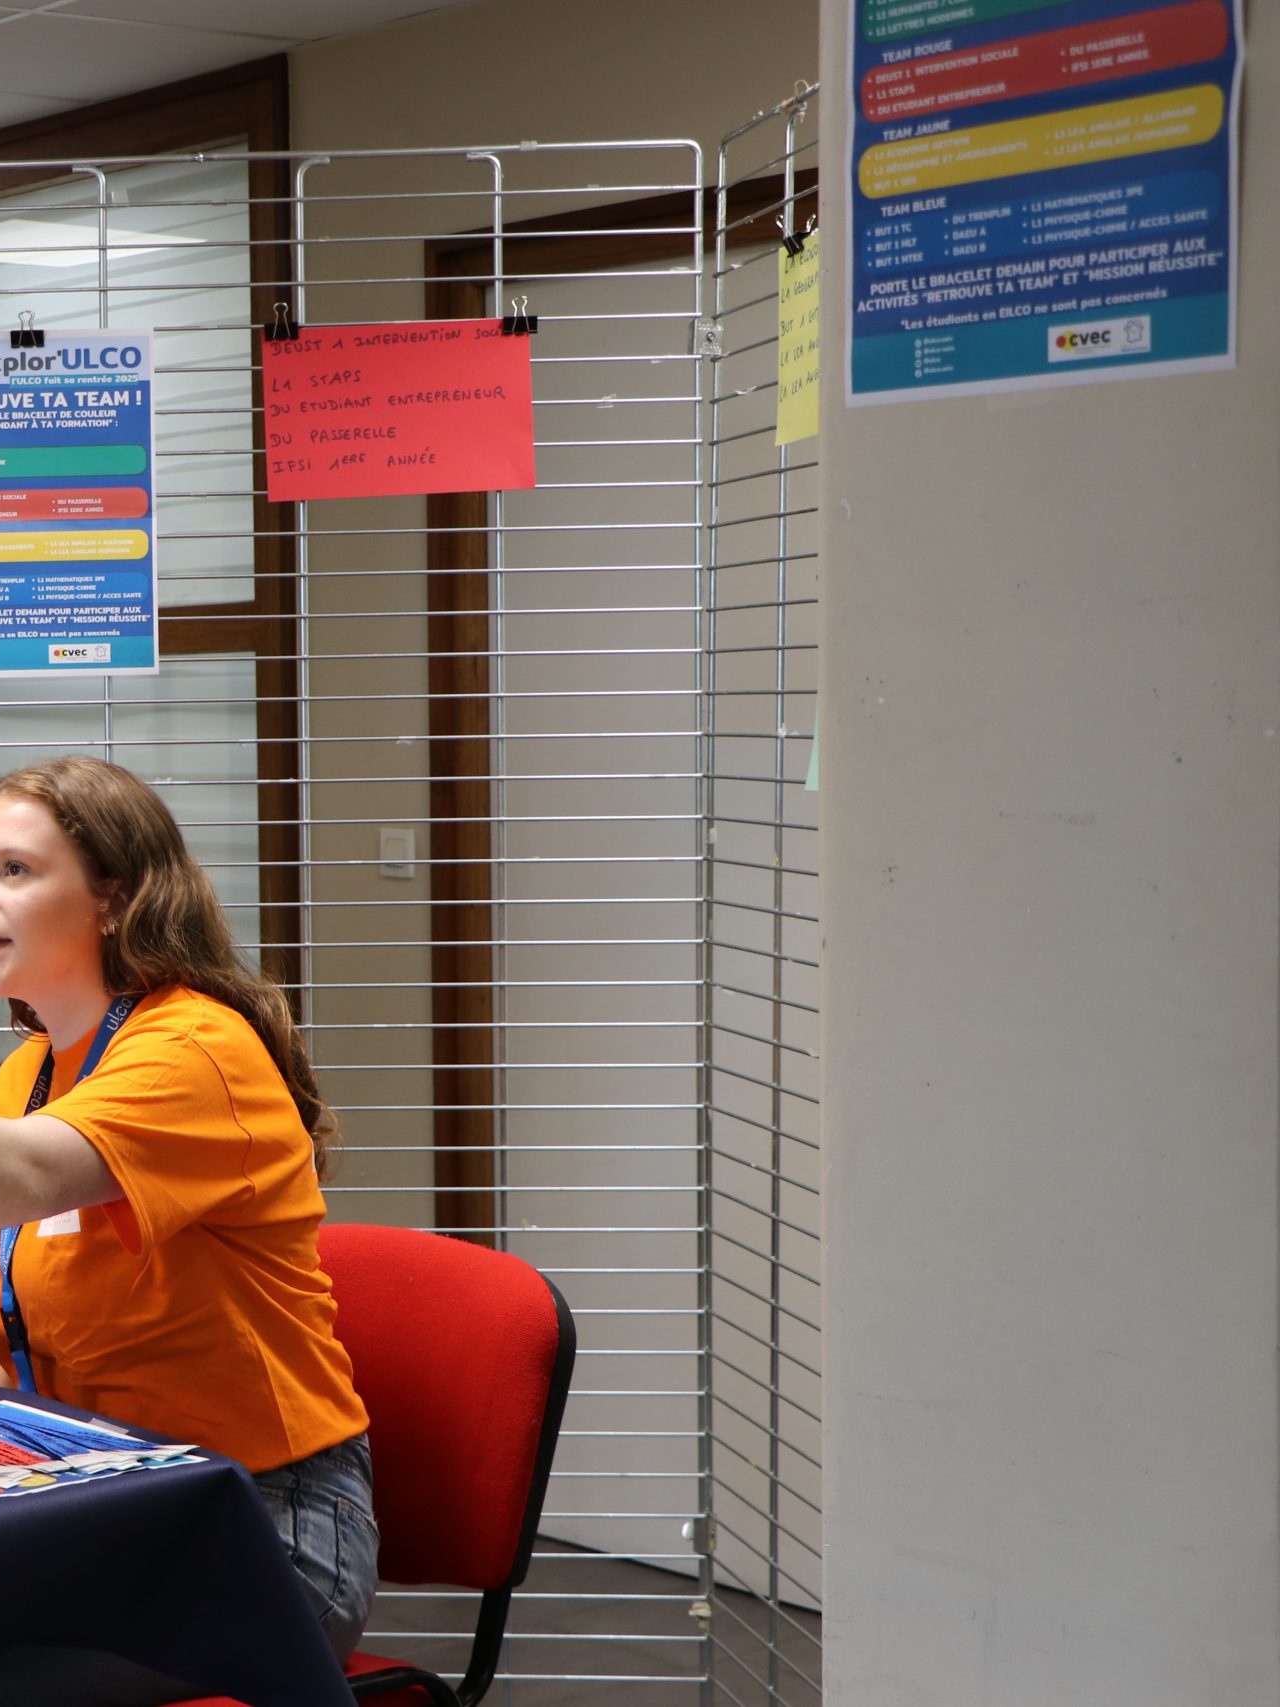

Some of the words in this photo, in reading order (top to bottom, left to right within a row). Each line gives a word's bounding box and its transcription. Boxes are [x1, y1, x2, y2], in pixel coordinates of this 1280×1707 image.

[881, 49, 911, 63] TEAM
[914, 40, 952, 57] ROUGE
[875, 70, 902, 84] DEUST
[915, 56, 978, 76] INTERVENTION
[980, 47, 1019, 63] SOCIALE
[888, 84, 915, 98] STAPS
[892, 96, 935, 113] ETUDIANT
[938, 83, 1006, 104] ENTREPRENEUR
[882, 127, 912, 141] TEAM
[914, 120, 950, 136] JAUNE
[881, 202, 910, 218] TEAM
[913, 197, 947, 213] BLEUE
[1044, 189, 1122, 211] MATHEMATIQUES
[952, 214, 966, 225] DU
[968, 207, 1011, 222] TREMPLIN
[875, 225, 892, 237] BUT
[901, 223, 912, 233] TC
[952, 228, 977, 240] DAEU
[979, 227, 987, 236] A
[875, 240, 892, 252] BUT
[952, 244, 977, 256] DAEU
[870, 280, 909, 296] PORTE
[912, 277, 926, 290] LE
[929, 268, 992, 288] BRACELET
[996, 260, 1045, 278] DEMAIN
[1049, 254, 1085, 271] POUR
[1089, 243, 1169, 265] PARTICIPER
[1173, 237, 1206, 254] AUX
[875, 256, 892, 268] BUT
[857, 291, 918, 313] ACTIVITÉS
[996, 281, 1014, 294] TA
[1063, 272, 1079, 285] ET
[926, 313, 979, 328] étudiants
[982, 311, 996, 320] en
[999, 305, 1031, 319] EILCO
[1034, 304, 1048, 314] ne
[1051, 300, 1078, 312] sont
[1081, 295, 1102, 310] pas
[1105, 287, 1167, 305] concernés
[271, 340, 323, 356] DEUST
[332, 338, 343, 350] 1
[1069, 328, 1111, 348] cvec
[44, 376, 61, 385] fait
[77, 375, 112, 384] rentrée
[272, 378, 292, 393] L1
[310, 370, 362, 387] STAPS
[40, 392, 69, 408] TA
[74, 390, 130, 407] TEAM
[135, 390, 142, 406] !
[270, 403, 291, 418] DU
[388, 386, 507, 406] ENTREPRENEUR
[0, 412, 10, 420] LE
[12, 411, 58, 420] BRACELET
[74, 409, 117, 418] COULEUR
[31, 419, 39, 429] À
[41, 420, 53, 428] TA
[270, 433, 293, 448] DU
[310, 427, 397, 444] PASSERELLE
[387, 446, 437, 468] ANNÉE
[15, 608, 47, 616] DEMAIN
[49, 607, 72, 615] POUR
[73, 606, 121, 615] PARTICIPER
[123, 606, 141, 614] AUX
[57, 616, 67, 624] ET
[62, 649, 87, 657] cvec
[107, 998, 133, 1031] ulco
[30, 1075, 48, 1108] ulco
